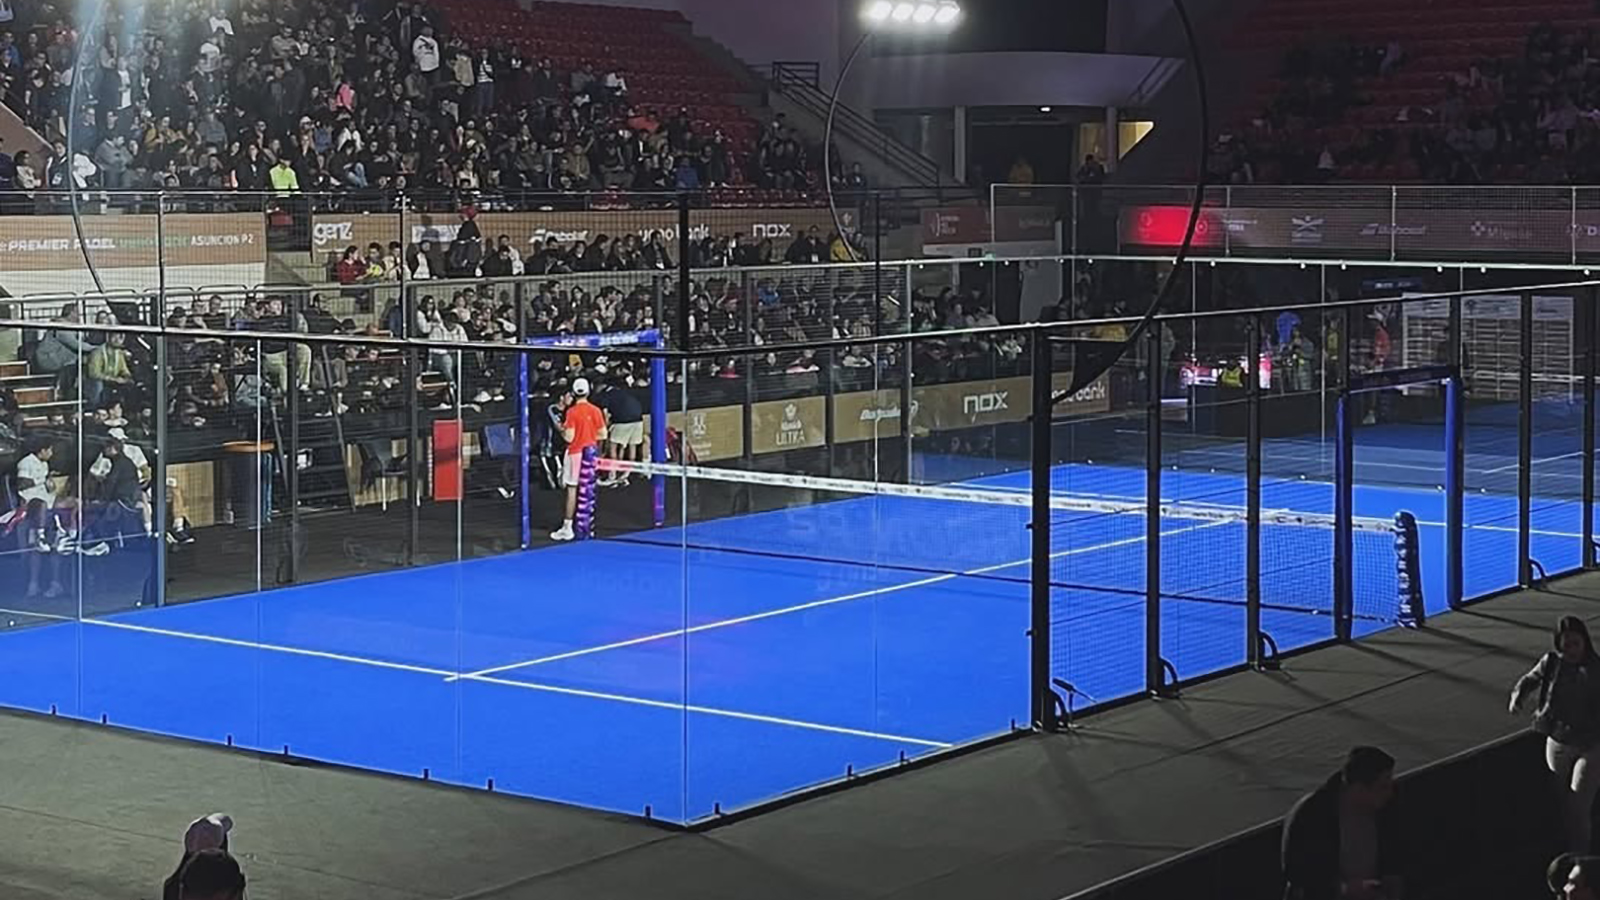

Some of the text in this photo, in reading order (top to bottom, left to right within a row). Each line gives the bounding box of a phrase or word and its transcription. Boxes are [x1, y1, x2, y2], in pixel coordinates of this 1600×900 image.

[313, 222, 352, 245] genz
[753, 223, 791, 238] nox
[9, 238, 69, 252] PREMIER
[74, 238, 116, 250] PADEL
[191, 234, 239, 246] ASUNCION
[241, 233, 254, 245] P2
[964, 391, 1008, 414] nox
[776, 430, 806, 446] ULTRA
